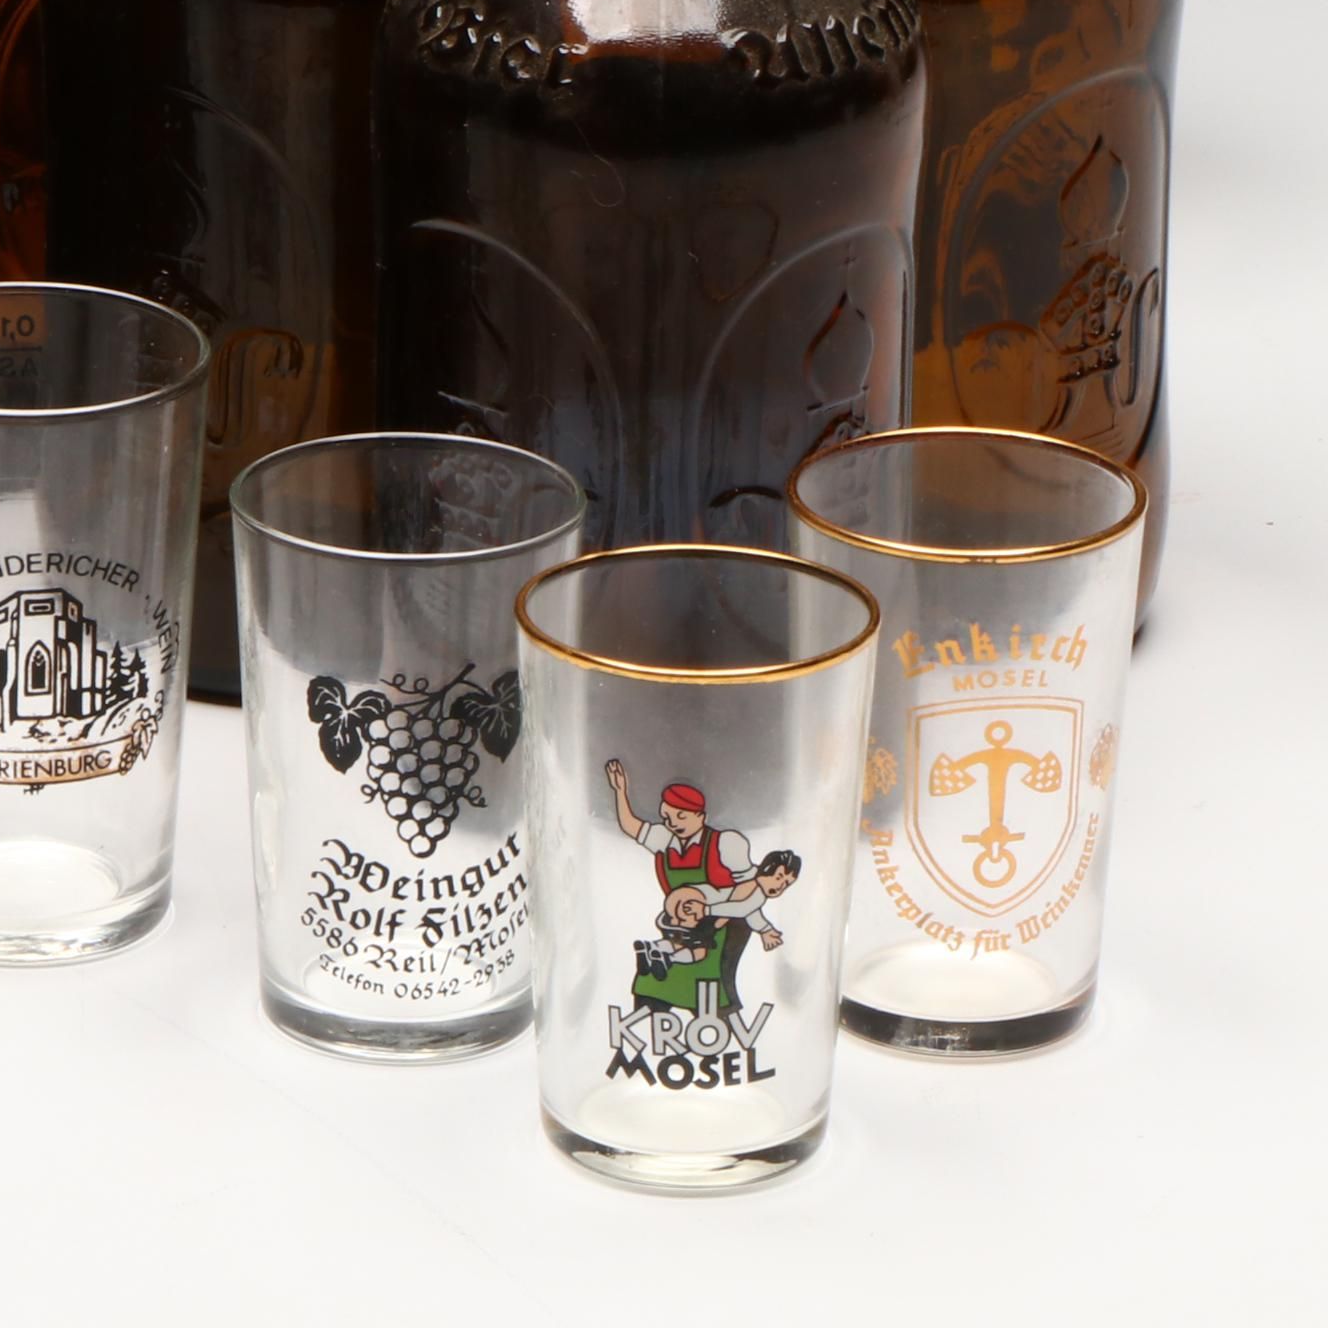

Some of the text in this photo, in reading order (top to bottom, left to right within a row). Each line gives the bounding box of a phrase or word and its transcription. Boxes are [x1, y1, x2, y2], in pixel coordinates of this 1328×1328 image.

[892, 621, 1088, 680] Enkirch
[952, 670, 1048, 692] MOSEL
[320, 831, 522, 902] Weingut
[862, 818, 966, 952] Ankerplatz
[971, 928, 1012, 961] für
[300, 906, 360, 958] 5586
[307, 870, 528, 949] Rolf Filzen
[319, 953, 385, 995] Telefon
[608, 980, 774, 1057] KRÖV
[605, 1047, 776, 1090] MOSEL
